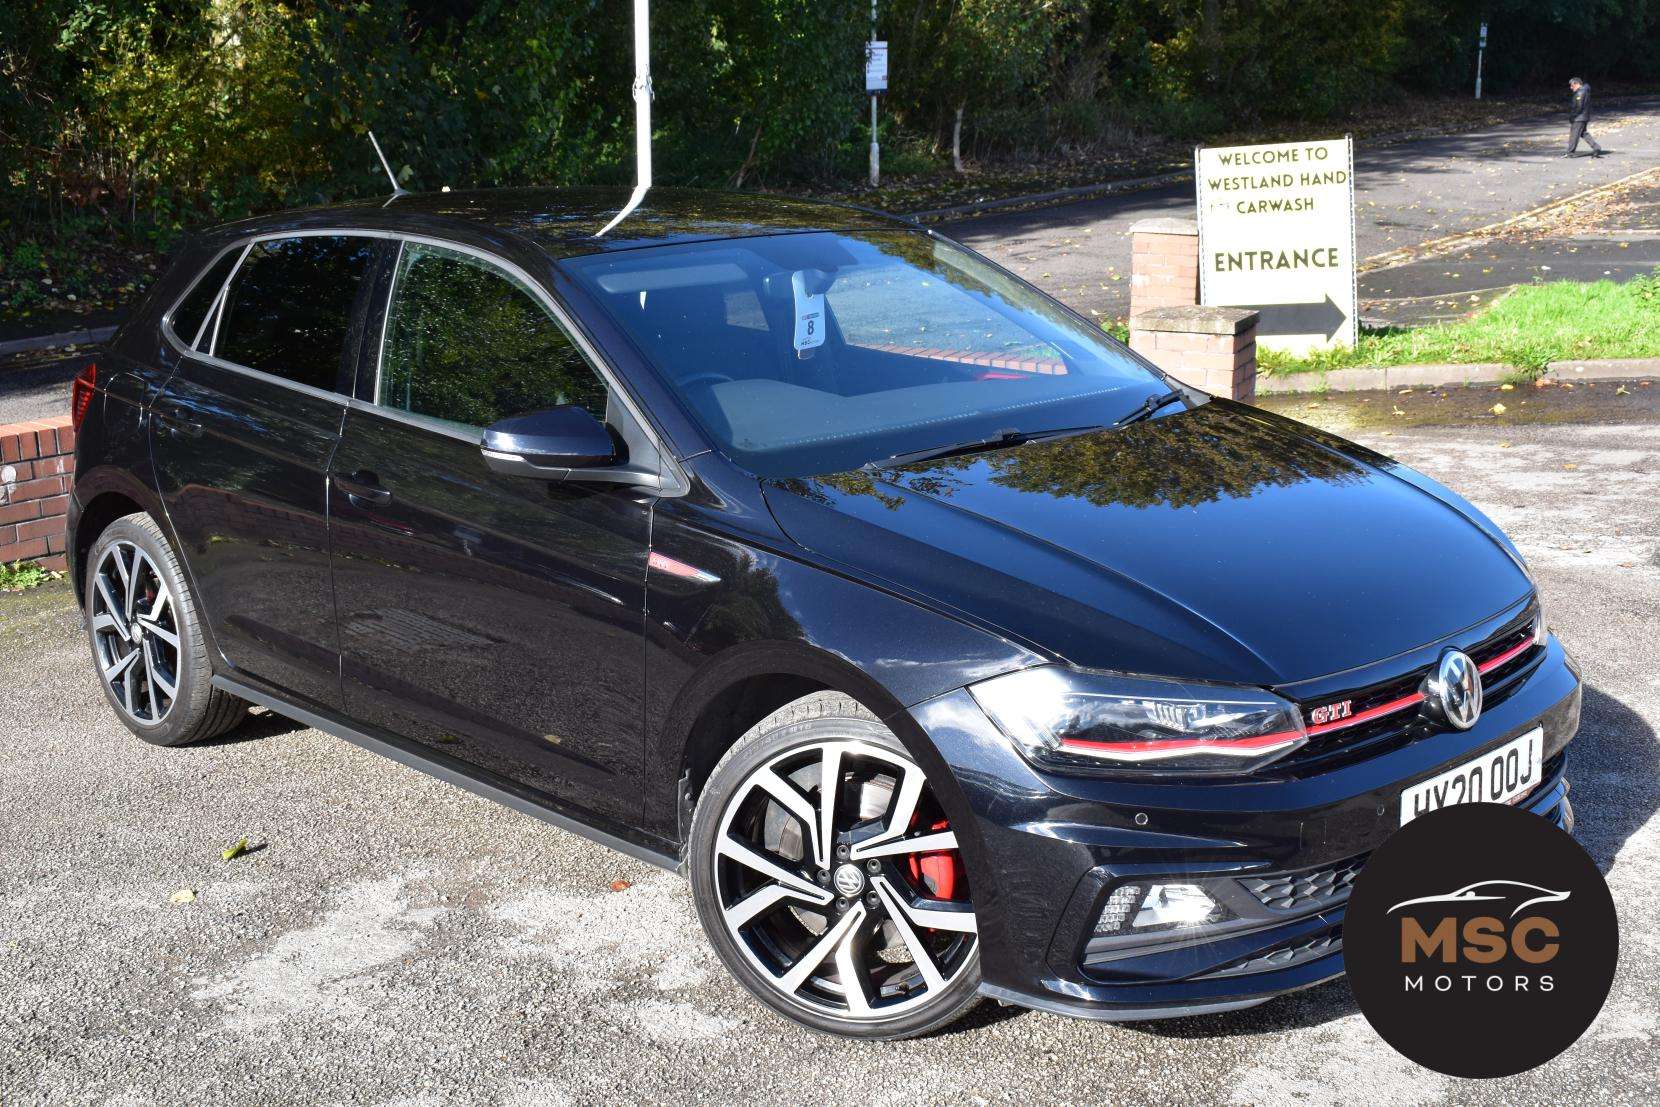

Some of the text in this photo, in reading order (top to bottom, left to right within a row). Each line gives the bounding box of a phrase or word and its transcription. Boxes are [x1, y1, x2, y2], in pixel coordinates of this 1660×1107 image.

[1218, 147, 1328, 166] WELCOME TO
[1208, 171, 1347, 191] WESTLAND HAND
[1236, 198, 1314, 214] CARWASH
[1215, 248, 1339, 272] ENTRANCE
[807, 320, 815, 335] 8
[1312, 700, 1352, 724] GTI
